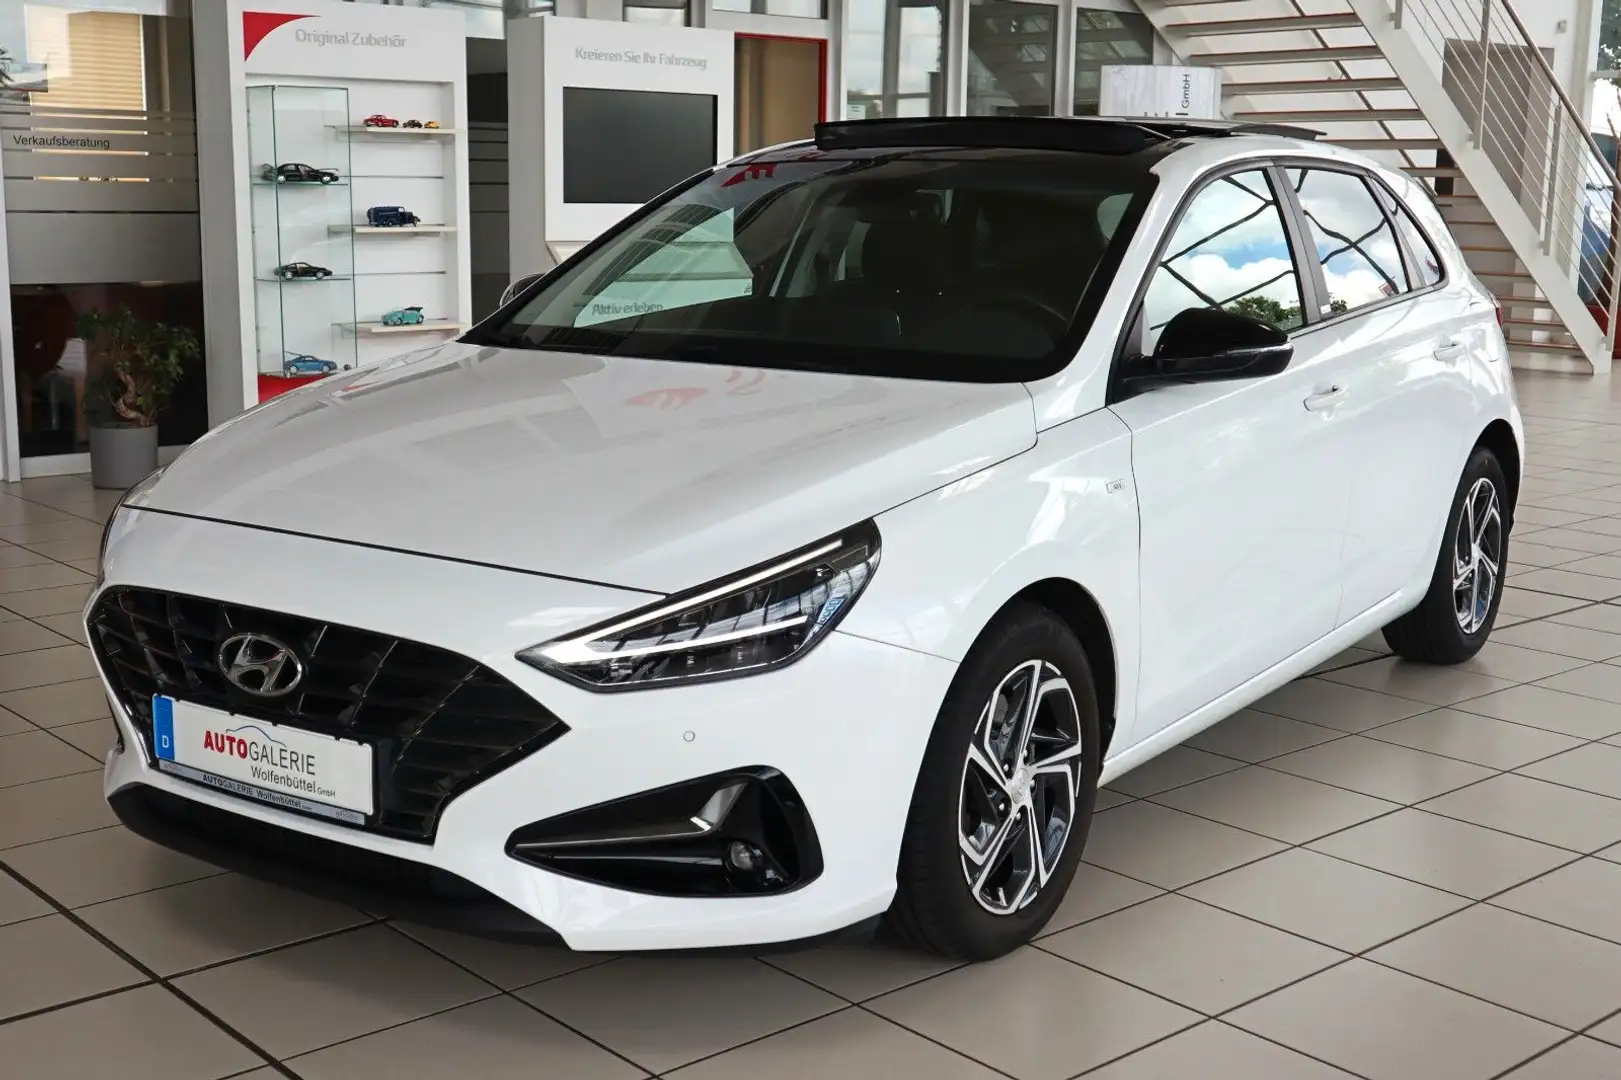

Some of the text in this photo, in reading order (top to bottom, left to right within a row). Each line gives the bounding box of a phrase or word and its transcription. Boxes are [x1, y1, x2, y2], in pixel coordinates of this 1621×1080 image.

[295, 28, 407, 48] Original Zubehör
[575, 46, 707, 71] Kreieren Sie Ihr Fahrzeug
[1181, 74, 1191, 109] GmbH
[13, 134, 111, 150] Verkaufsberatung
[591, 302, 664, 316] Aktiv erleben
[161, 734, 170, 749] D
[203, 730, 315, 775] AUTOGALERIE
[202, 773, 301, 809] AUTOGALERIE Wolfenbüttel
[251, 765, 336, 799] Wolfenbüttel GmbH
